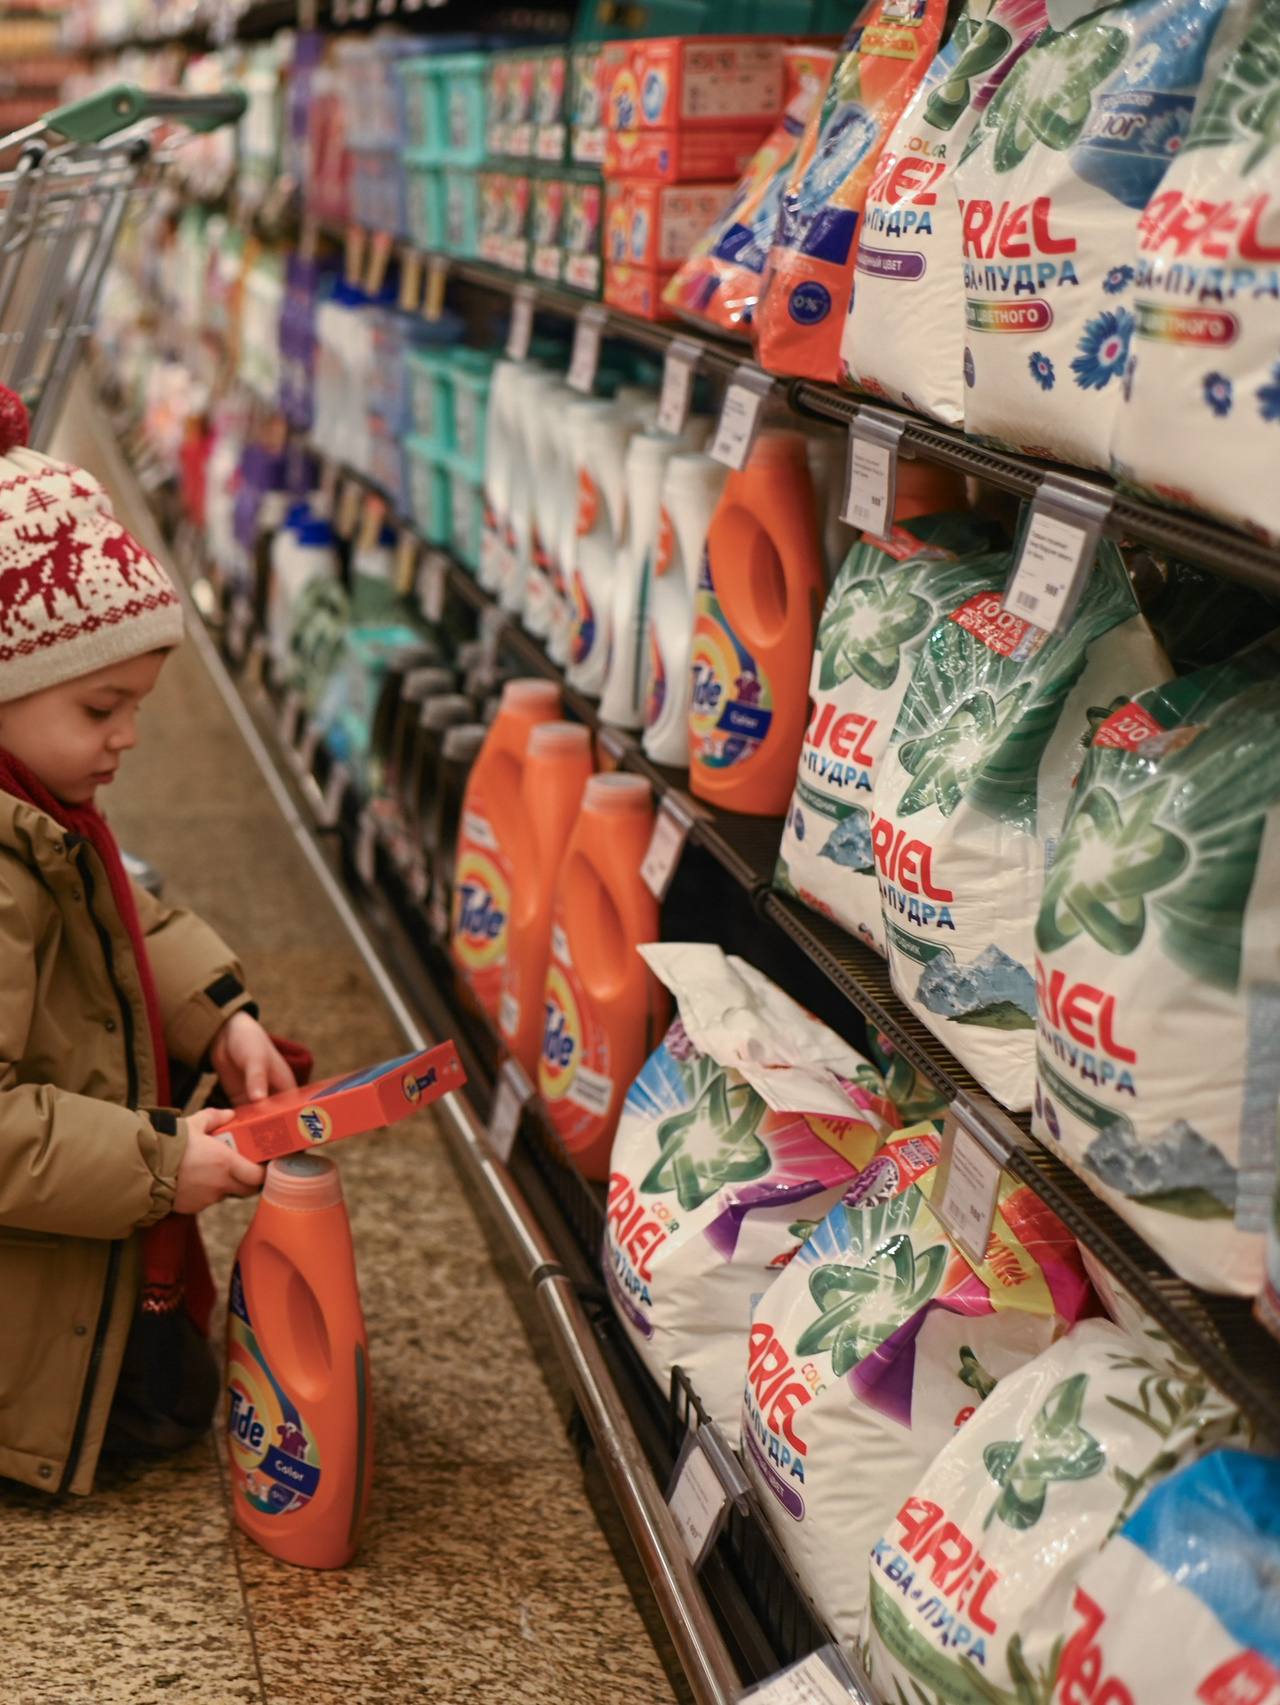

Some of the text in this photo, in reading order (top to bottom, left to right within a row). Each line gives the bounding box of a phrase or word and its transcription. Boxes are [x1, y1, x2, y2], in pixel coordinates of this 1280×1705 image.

[904, 136, 947, 159] OLOR
[959, 197, 1077, 260] RIEL
[977, 308, 1039, 325] ЦВЕТНОГО
[871, 811, 954, 903] RIEL
[457, 885, 506, 939] Tide
[299, 1109, 324, 1141] Tide
[748, 1323, 812, 1457] ARIEL
[274, 1459, 305, 1482] Color
[870, 1538, 916, 1597] КВА
